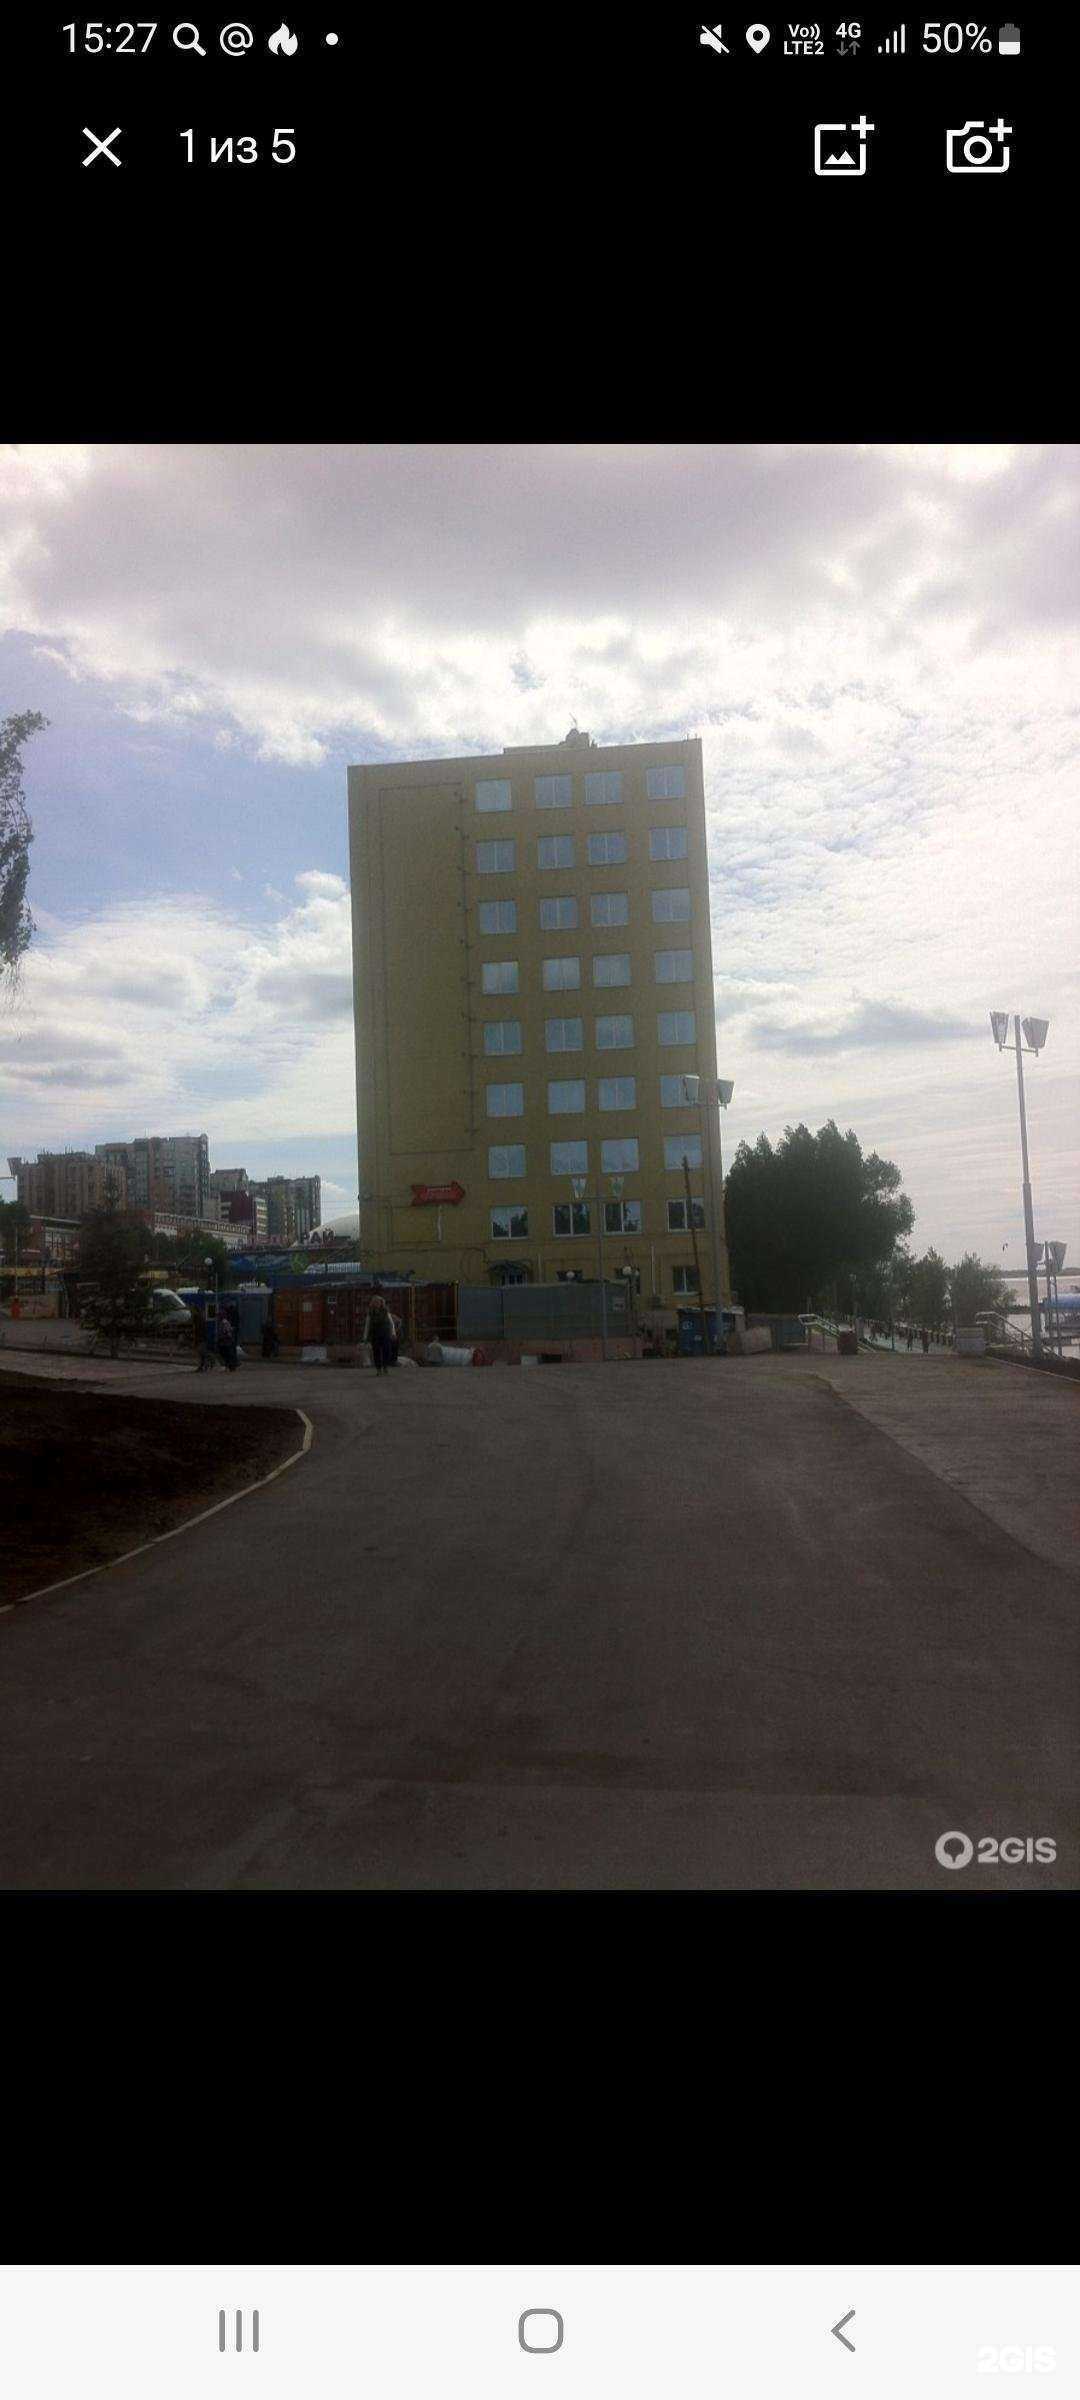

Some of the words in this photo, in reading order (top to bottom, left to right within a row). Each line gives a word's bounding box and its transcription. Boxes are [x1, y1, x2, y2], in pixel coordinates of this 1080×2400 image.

[63, 23, 157, 54] 15:27
[836, 23, 862, 39] 4G
[923, 23, 993, 54] 50%
[784, 40, 824, 55] LTE2
[180, 129, 193, 163] 1
[210, 136, 258, 164] из
[271, 128, 296, 164] 5
